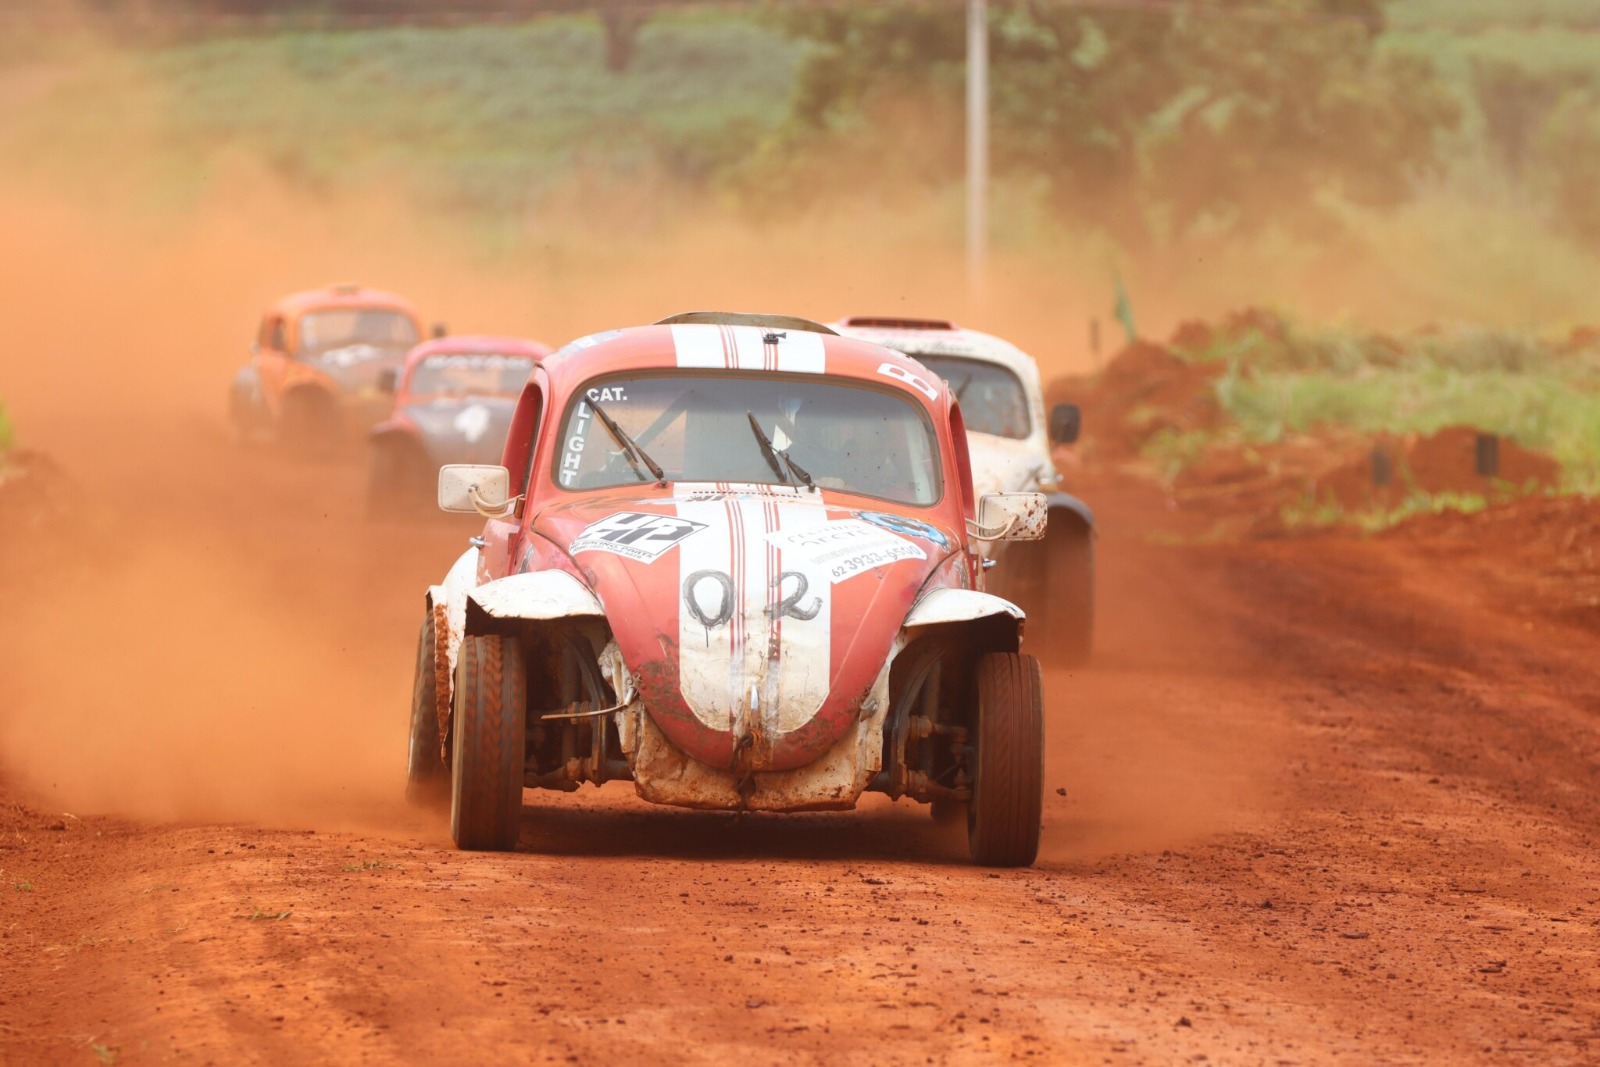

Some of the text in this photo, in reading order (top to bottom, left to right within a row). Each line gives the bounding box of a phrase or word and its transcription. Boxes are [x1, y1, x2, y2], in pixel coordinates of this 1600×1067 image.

[586, 387, 628, 402] CAT.
[562, 401, 590, 485] LIGHT
[831, 565, 847, 578] 62
